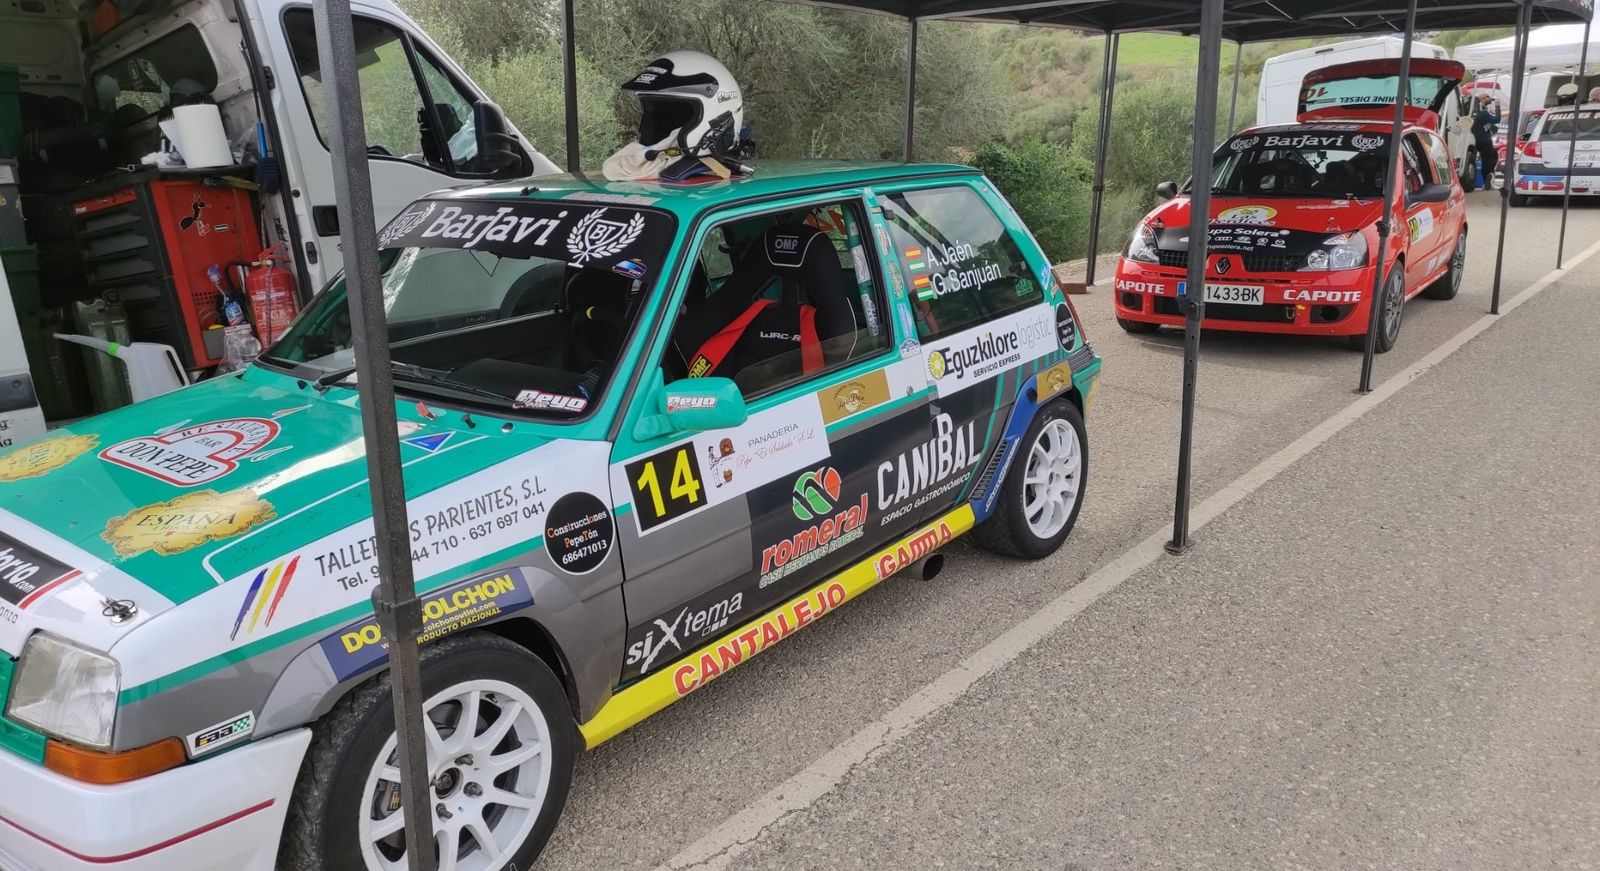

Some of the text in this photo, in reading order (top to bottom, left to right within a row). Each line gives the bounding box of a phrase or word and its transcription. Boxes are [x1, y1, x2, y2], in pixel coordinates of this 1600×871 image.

[1339, 95, 1372, 104] DIESEL
[1547, 111, 1592, 121] TALLEES
[1264, 134, 1345, 148] BarJavi
[421, 206, 569, 248] BarJavi
[1207, 227, 1280, 238] upo Solera
[774, 238, 798, 250] OMP
[926, 239, 975, 270] A.Jaén
[1206, 243, 1254, 252] ruposolera.net
[932, 260, 1002, 296] G.Sanjuán
[1282, 289, 1362, 302] CAPOTE
[938, 330, 1018, 380] Eguzkilore
[1016, 313, 1052, 350] logistic
[973, 352, 1021, 378] SERVICIO EXPRESS
[116, 441, 219, 480] DON PEPE
[637, 448, 701, 519] 14
[424, 485, 518, 536] PARIENTES,
[521, 475, 547, 499] S.L.
[880, 503, 913, 526] ESPACIO
[547, 511, 607, 538] Construcciones
[563, 528, 599, 549] PepeTón
[761, 492, 869, 576] romeral
[337, 571, 368, 591] Tel.
[411, 546, 429, 562] 44
[431, 535, 458, 555] 710
[469, 521, 493, 540] 637
[496, 511, 519, 529] 697
[522, 501, 545, 519] 041
[562, 539, 608, 565] 686471013
[340, 574, 516, 654] DO OLCHON
[416, 607, 502, 645] RODUCTO NACIONAL
[673, 582, 847, 697] CANTALEJO
